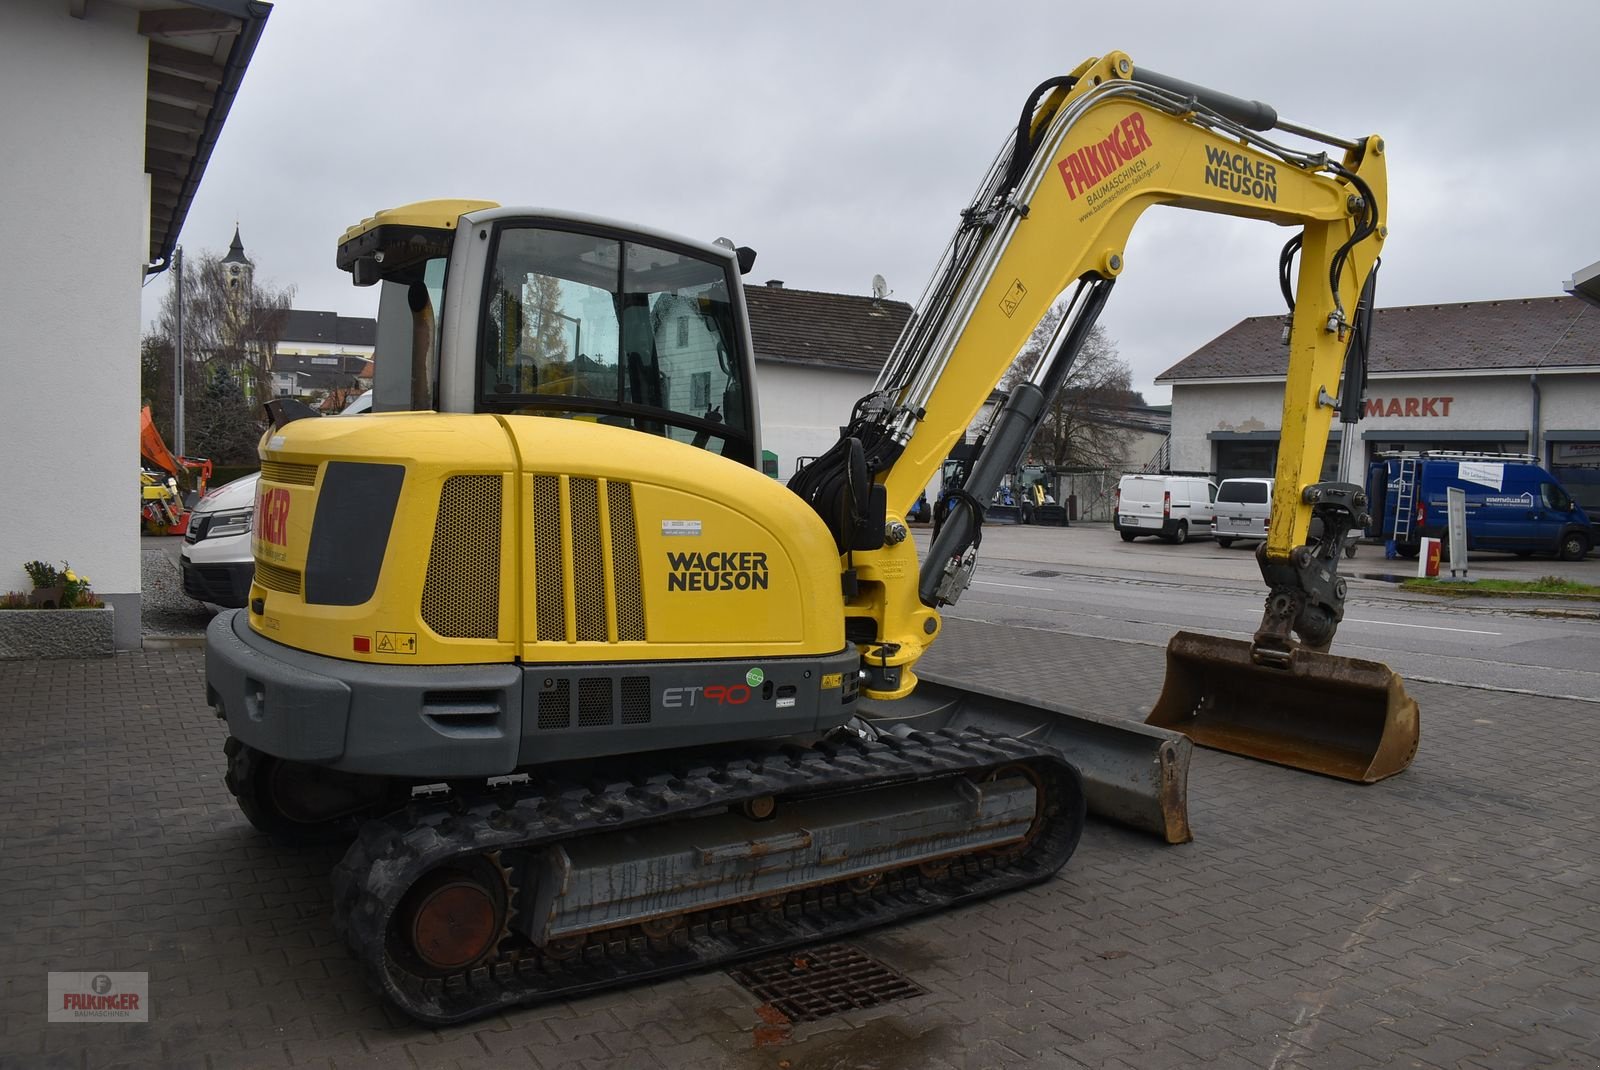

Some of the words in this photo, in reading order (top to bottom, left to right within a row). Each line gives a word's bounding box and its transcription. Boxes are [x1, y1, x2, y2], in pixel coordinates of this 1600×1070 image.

[1057, 112, 1153, 201] FALKINGER
[1205, 144, 1277, 184] WACKER
[1086, 158, 1148, 206] BAUMASCHINEN
[1205, 165, 1277, 204] NEUSON
[1364, 397, 1454, 417] MARKT
[667, 552, 768, 571] WACKER
[668, 572, 768, 591] NEUSON
